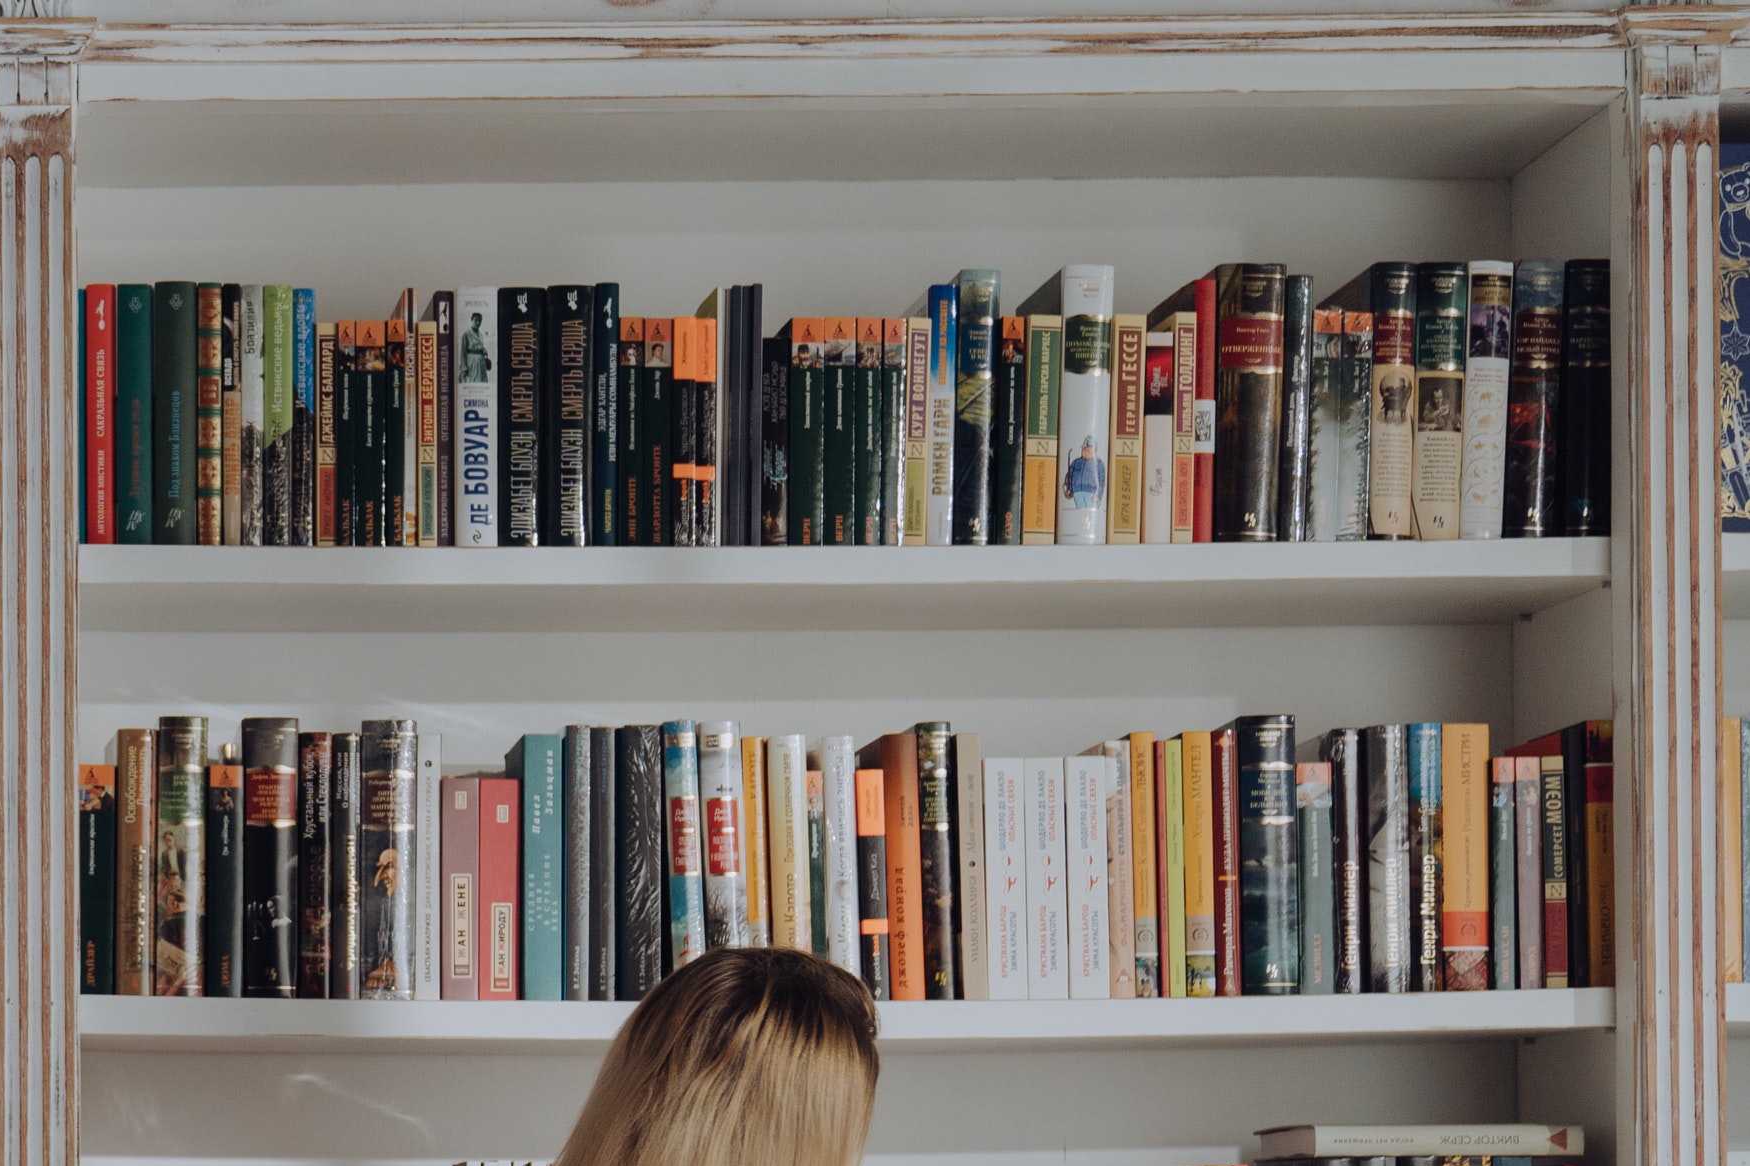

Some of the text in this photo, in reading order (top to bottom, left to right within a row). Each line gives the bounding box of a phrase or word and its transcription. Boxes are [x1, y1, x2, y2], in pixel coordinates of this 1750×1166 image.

[96, 350, 106, 437] САКРАЛЬНАЯ СВЯЗЬ
[272, 302, 284, 412] Иствикские ведьмы
[320, 341, 334, 443] ДЖЕЙМС БАЛЛАРД
[512, 322, 537, 422] СМЕРТЬ СЕРДЦА
[911, 332, 925, 436] КУРТ ВОННЕГУТ
[1121, 333, 1138, 432] ГЕРМАН ГЕССЕ
[464, 409, 492, 525] ДЕ БОВУАР
[511, 431, 534, 538] ЭЛИЗАБЕТ БОУЭН
[653, 444, 661, 543] ШАРЛОТТА БРОНТЕ
[532, 750, 555, 834] Павел Зальцман
[1546, 776, 1564, 878] СОМЕРСЕТ МОЭМ
[456, 882, 467, 959] ЖАН ЖЕНЕ
[497, 910, 508, 975] ЖАН ЖИРОДУ
[894, 867, 907, 988] джозеф конрад
[1039, 905, 1048, 978] КРИСТИАНА БАРОШ
[1050, 947, 1058, 971] ЗИМА
[1420, 854, 1436, 965] Генри Миллер
